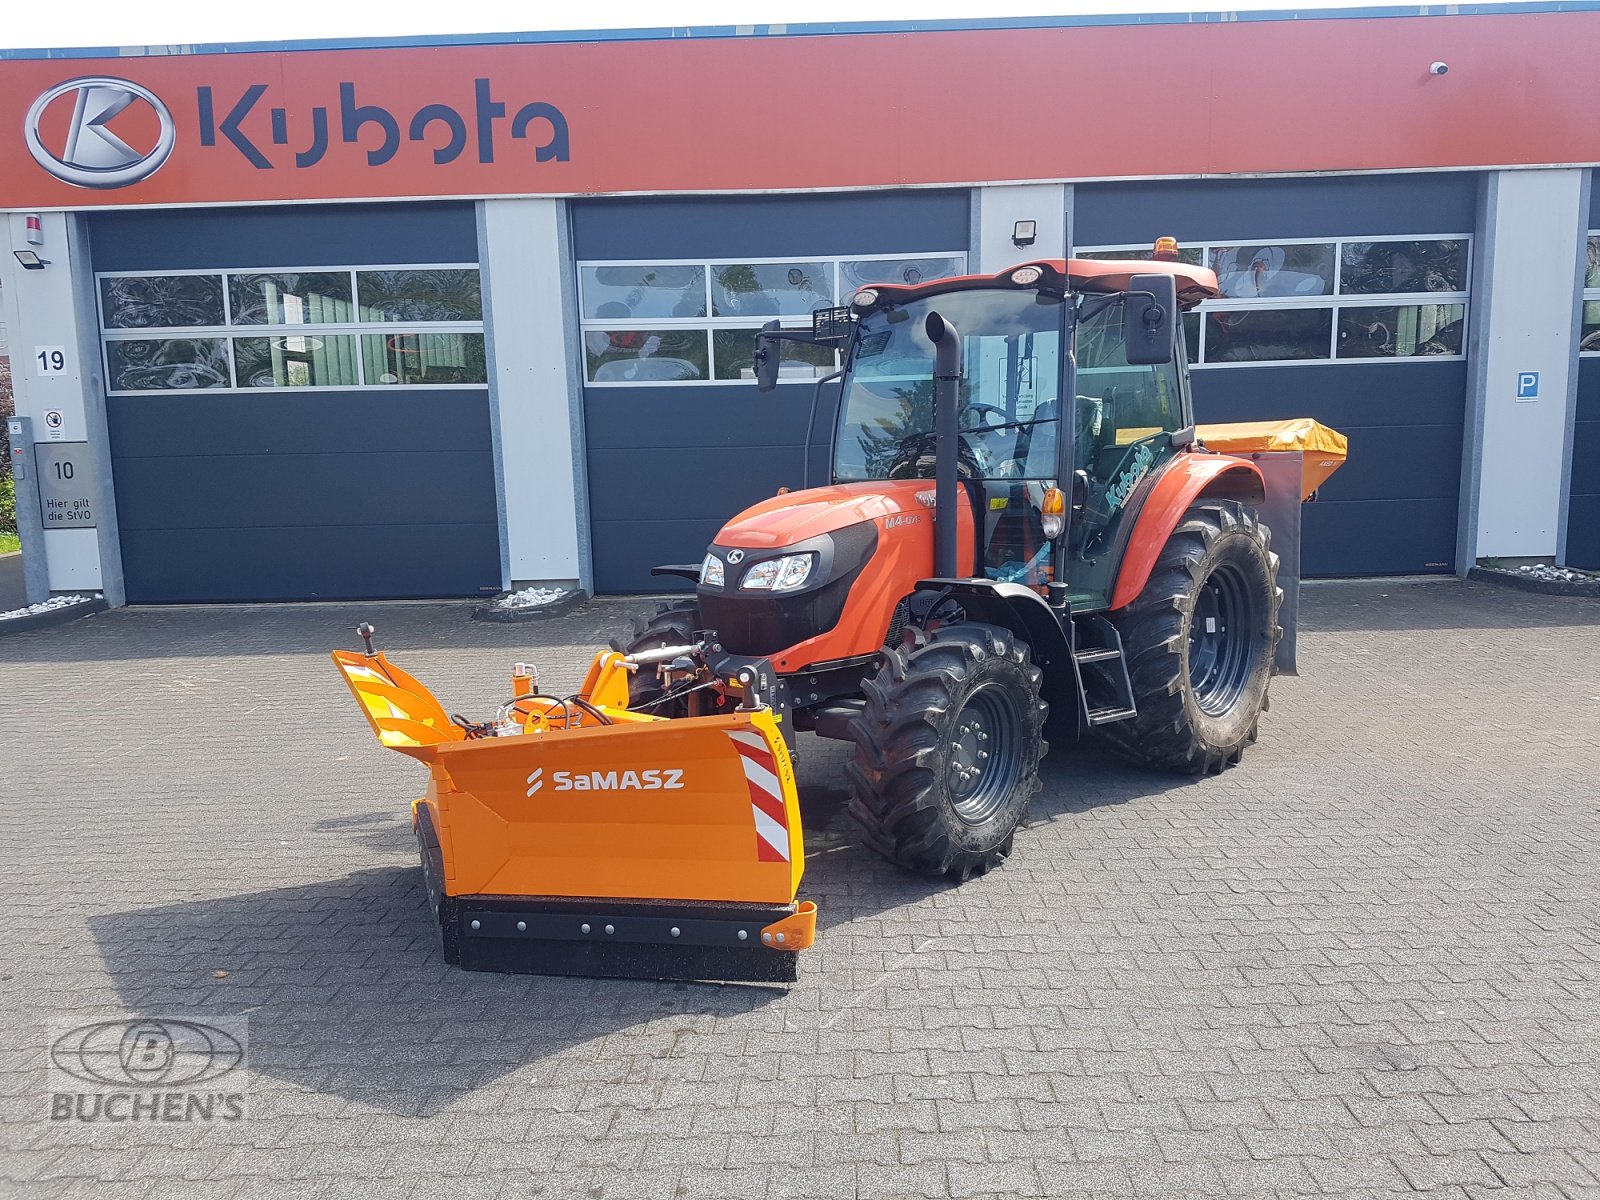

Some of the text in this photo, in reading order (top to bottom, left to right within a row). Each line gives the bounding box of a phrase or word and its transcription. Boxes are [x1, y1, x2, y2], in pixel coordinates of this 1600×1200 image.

[197, 78, 570, 169] Kubota
[38, 351, 64, 371] 19
[1520, 375, 1536, 394] P
[54, 462, 74, 479] 10
[1105, 445, 1151, 508] Kubota
[47, 499, 89, 510] Hier gilt
[48, 511, 91, 520] die StVO
[553, 769, 685, 791] SaMASZ
